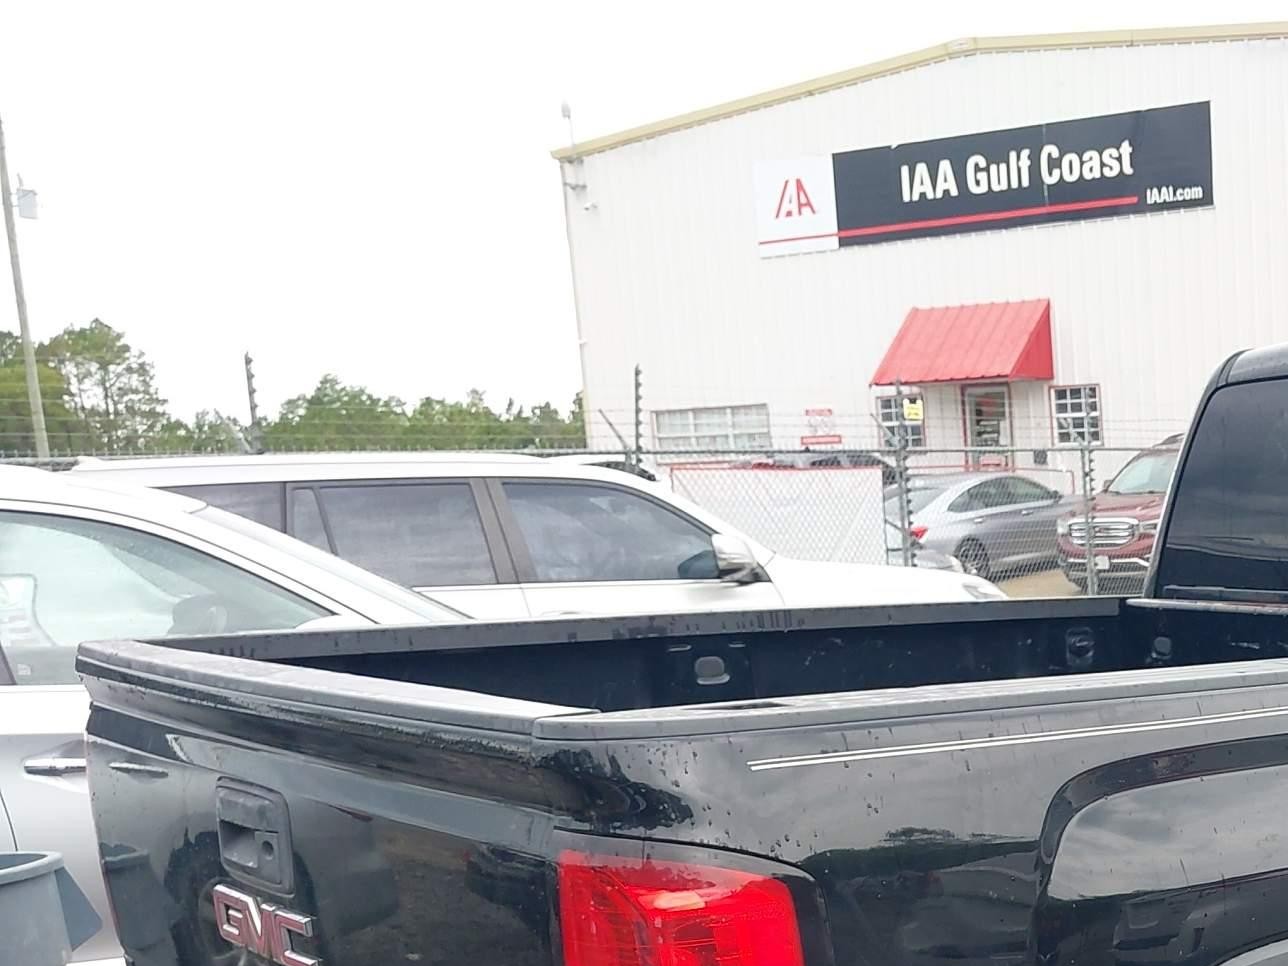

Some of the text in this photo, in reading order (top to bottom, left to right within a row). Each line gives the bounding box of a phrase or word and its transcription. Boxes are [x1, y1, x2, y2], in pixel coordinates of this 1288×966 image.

[900, 139, 1134, 203] IAA Gulf Coast
[1146, 184, 1203, 204] IAAI.com
